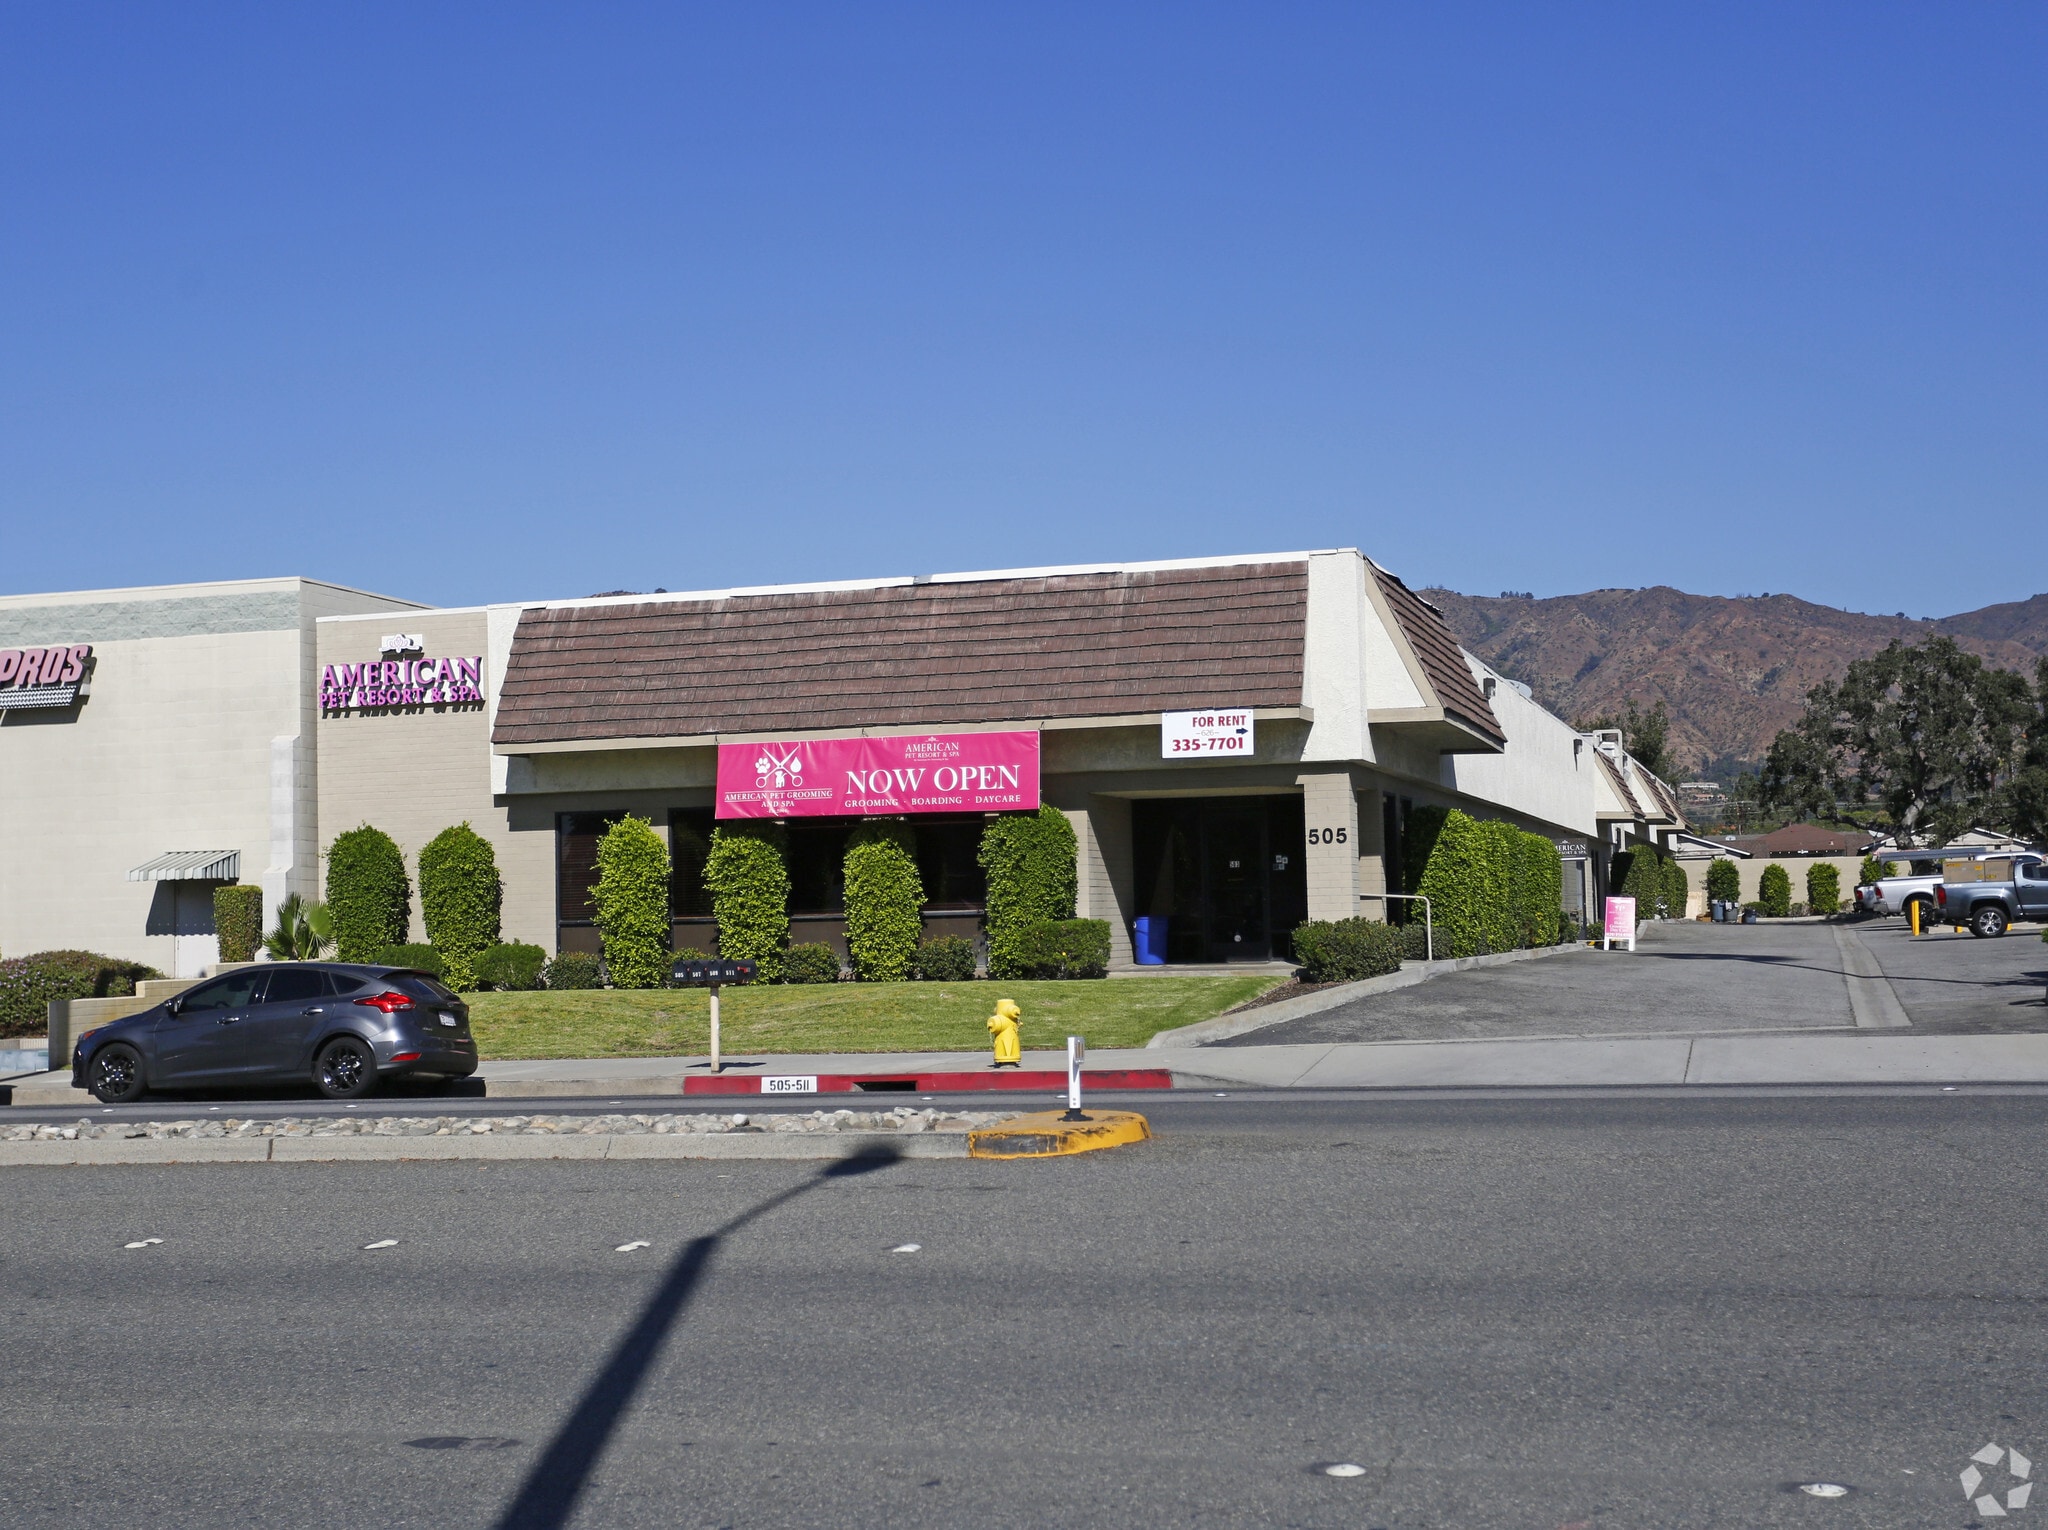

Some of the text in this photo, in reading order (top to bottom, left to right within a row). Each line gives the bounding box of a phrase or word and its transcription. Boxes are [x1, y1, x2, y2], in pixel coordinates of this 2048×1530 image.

[319, 656, 482, 690] AMERICAN
[319, 685, 481, 709] PET RESORT & SPA
[1192, 715, 1247, 728] FOR RENT
[905, 742, 960, 753] AMERICAN
[1172, 737, 1244, 752] 335-7701
[845, 765, 1022, 795] NOW OPEN
[724, 793, 767, 802] AMERICAN
[786, 790, 833, 798] GROOMING
[844, 795, 1021, 808] GROOMING BOARDING DAYCARE
[1308, 827, 1348, 845] 505
[769, 1079, 810, 1091] 505-511
